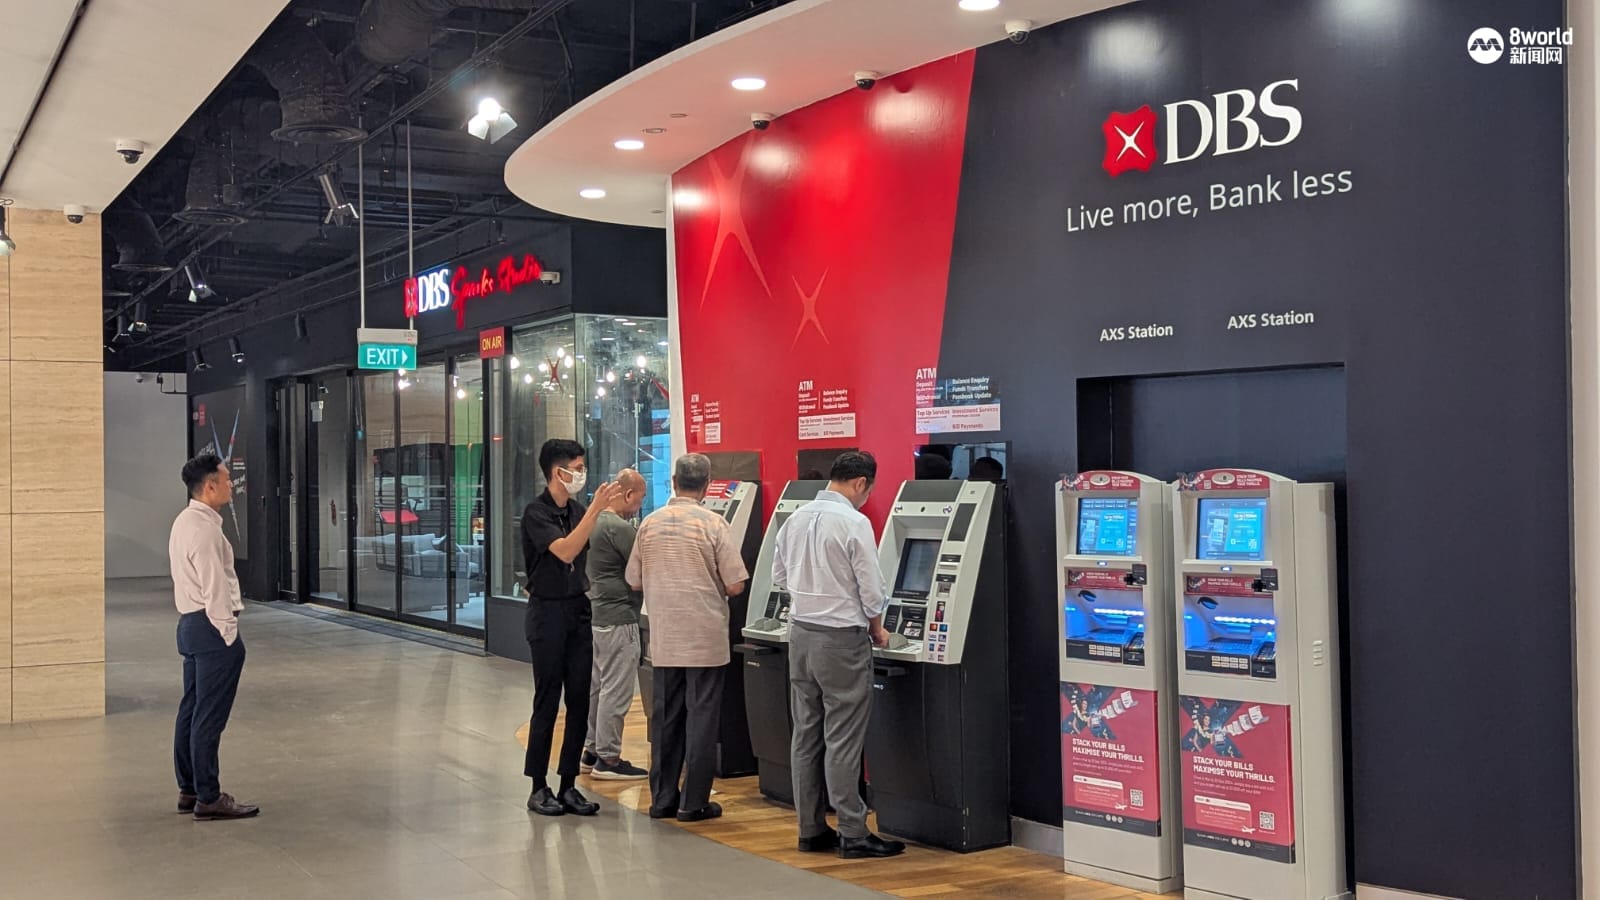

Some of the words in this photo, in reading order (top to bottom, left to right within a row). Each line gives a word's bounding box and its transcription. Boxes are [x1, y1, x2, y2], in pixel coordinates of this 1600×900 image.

[1163, 78, 1302, 165] DBS
[1067, 205, 1114, 232] Live
[1123, 193, 1200, 224] more,
[1209, 175, 1282, 211] Bank
[1293, 170, 1353, 199] less
[418, 269, 450, 313] DBS
[1227, 314, 1256, 330] AXS
[1261, 310, 1315, 327] Station
[1100, 327, 1125, 342] AXS
[1128, 323, 1174, 339] Station
[482, 338, 492, 351] ON
[492, 335, 502, 349] AIR
[366, 348, 399, 365] EXIT
[916, 367, 937, 380] ATM
[799, 380, 814, 392] ATM
[1072, 738, 1091, 747] STACK
[1091, 740, 1107, 749] YOUR
[1108, 743, 1125, 752] BILLS
[1072, 746, 1100, 757] MAXIMISE
[1101, 750, 1117, 759] YOUR
[1193, 756, 1214, 765] STACK
[1214, 759, 1232, 768] YOUR
[1233, 761, 1254, 771] BILLS
[1193, 765, 1224, 776] MAXIMISE
[1225, 769, 1244, 778] YOUR
[1245, 771, 1276, 783] THRILLS.
